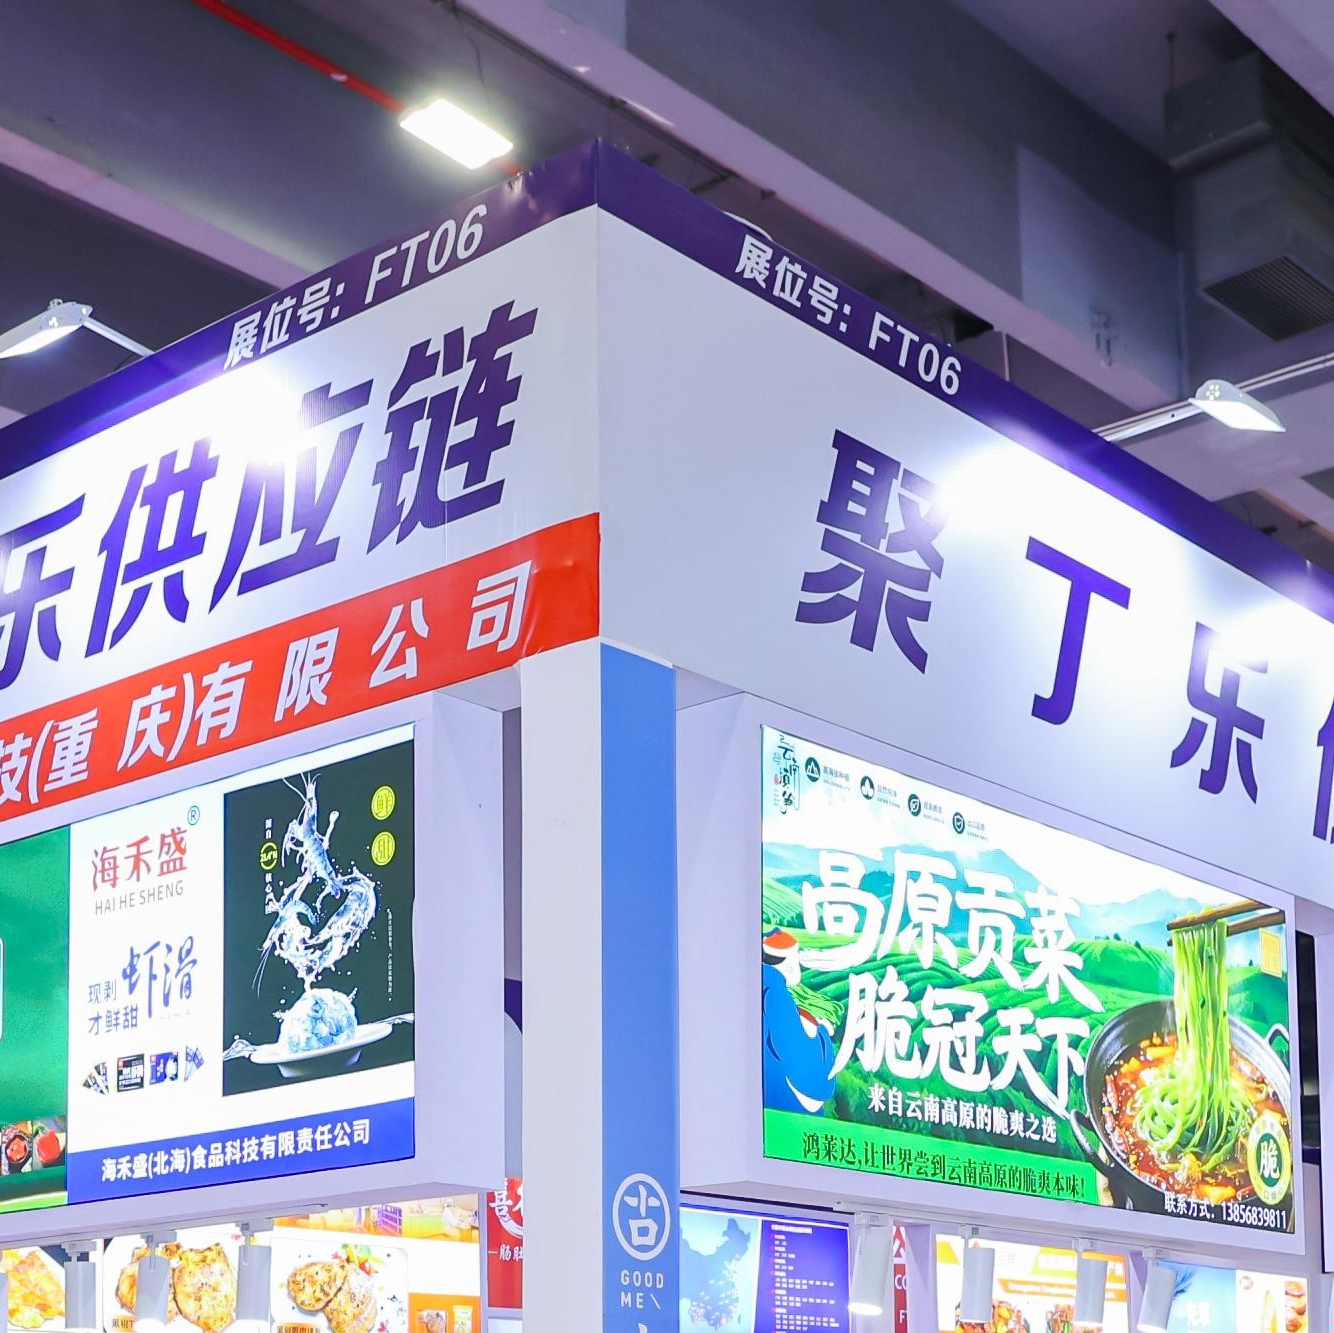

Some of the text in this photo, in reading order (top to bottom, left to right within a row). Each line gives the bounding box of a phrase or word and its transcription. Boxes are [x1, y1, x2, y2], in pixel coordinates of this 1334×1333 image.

[92, 825, 188, 892] 海禾盛
[94, 884, 185, 917] HAI HE SHENG
[801, 849, 1105, 1013] 高原贡菜
[87, 979, 118, 1005] 现剥
[121, 935, 198, 1019] 虾滑
[87, 1003, 139, 1036] 才鲜甜
[828, 973, 1091, 1120] 脆冠天下
[867, 1083, 1059, 1144] 来自云南高原的脆爽之选
[1259, 1139, 1280, 1179] 脆
[620, 1269, 665, 1289] GOOD
